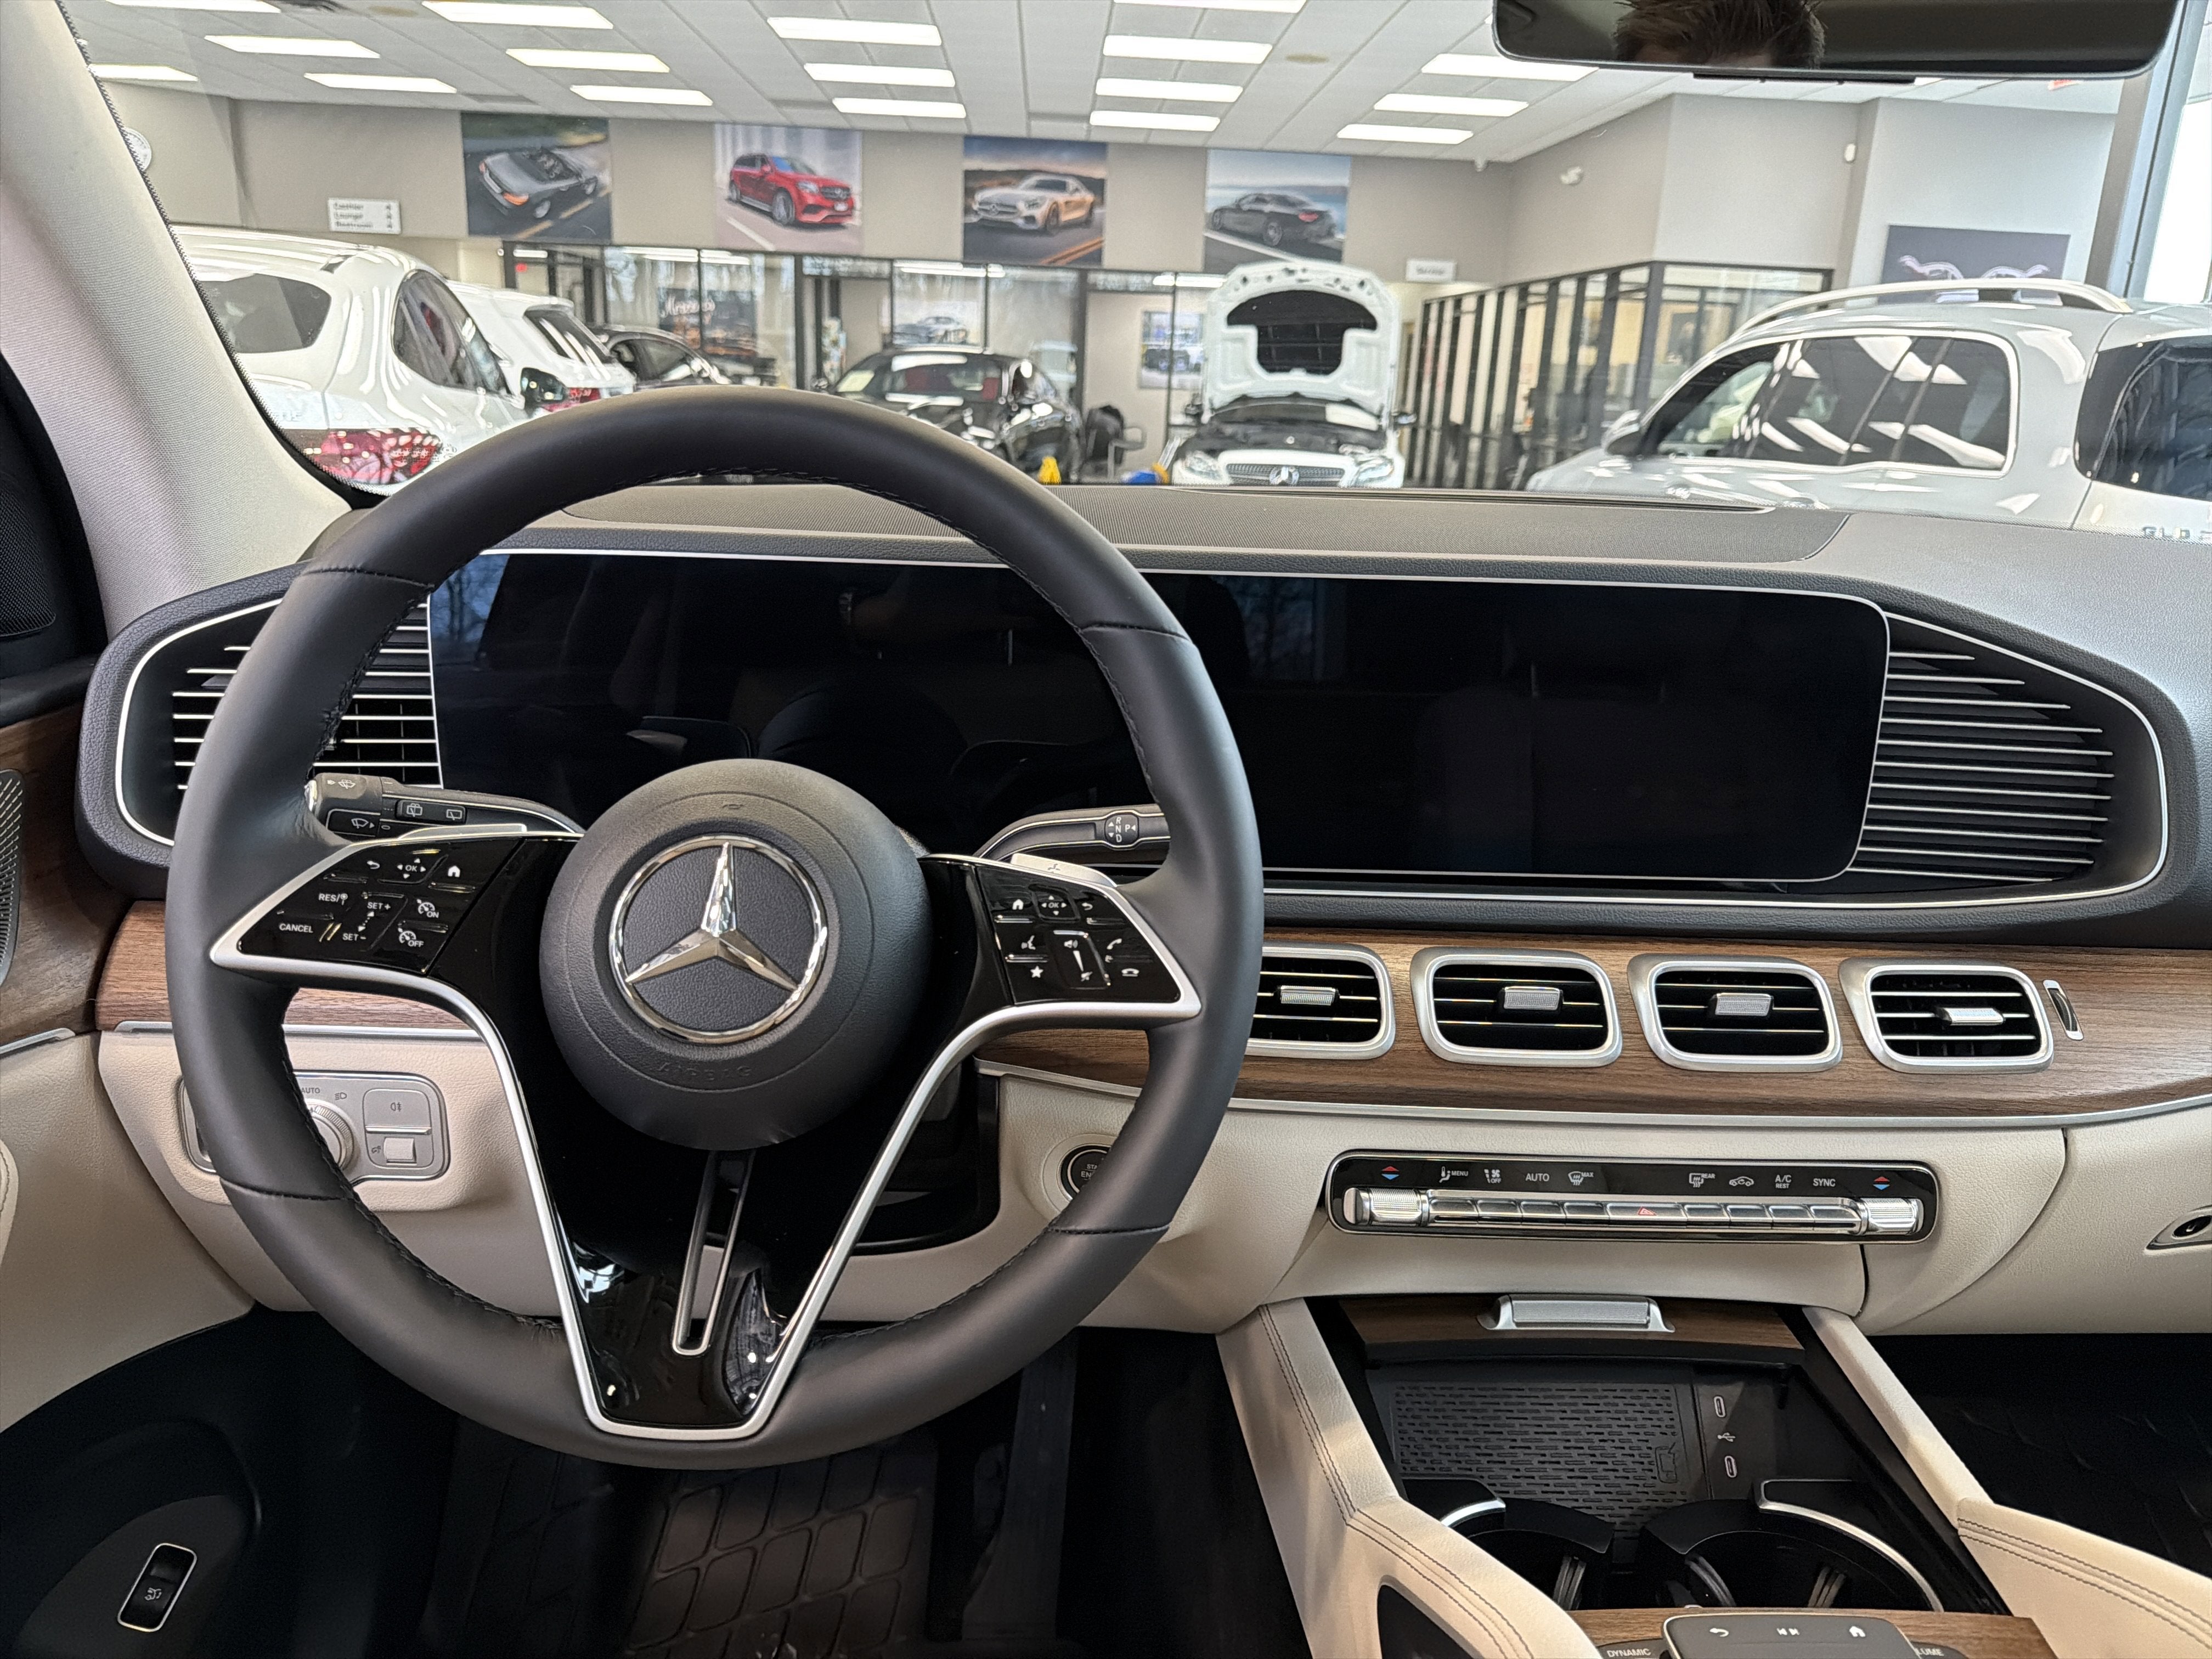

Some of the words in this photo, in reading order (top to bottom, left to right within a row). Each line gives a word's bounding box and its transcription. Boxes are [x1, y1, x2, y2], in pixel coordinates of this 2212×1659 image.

[1125, 824, 1131, 832] P
[1116, 834, 1122, 843] D
[279, 923, 313, 933] CANCEL
[1525, 1173, 1550, 1182] AUTO
[1775, 1174, 1792, 1183] A/C
[1813, 1178, 1836, 1187] SYNC
[1606, 1648, 1651, 1657] DYNAMIC
[1914, 1647, 1944, 1656] LUME
